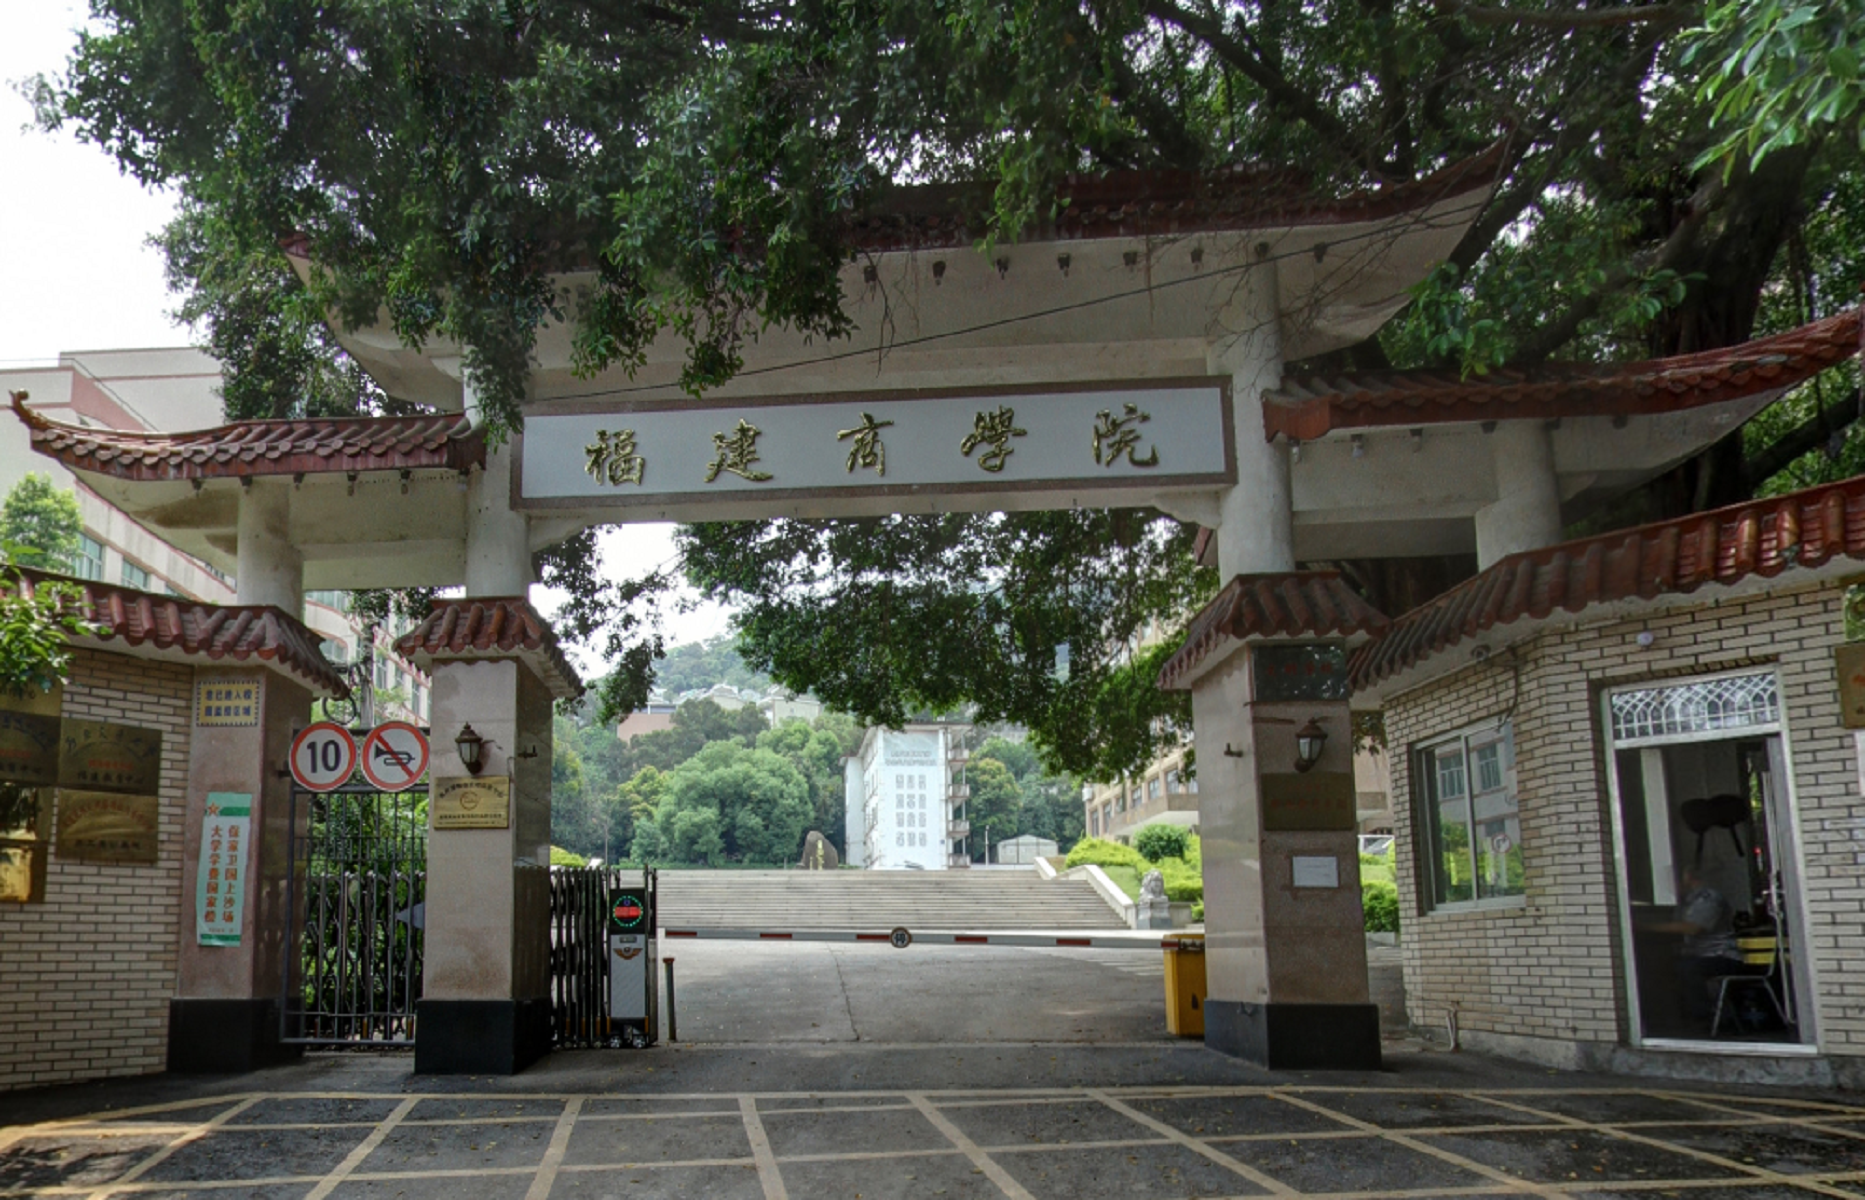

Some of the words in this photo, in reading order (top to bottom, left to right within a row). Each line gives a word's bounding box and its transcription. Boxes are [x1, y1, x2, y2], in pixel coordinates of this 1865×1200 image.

[306, 739, 341, 773] 10
[222, 825, 240, 923] 保家卫国上沙场
